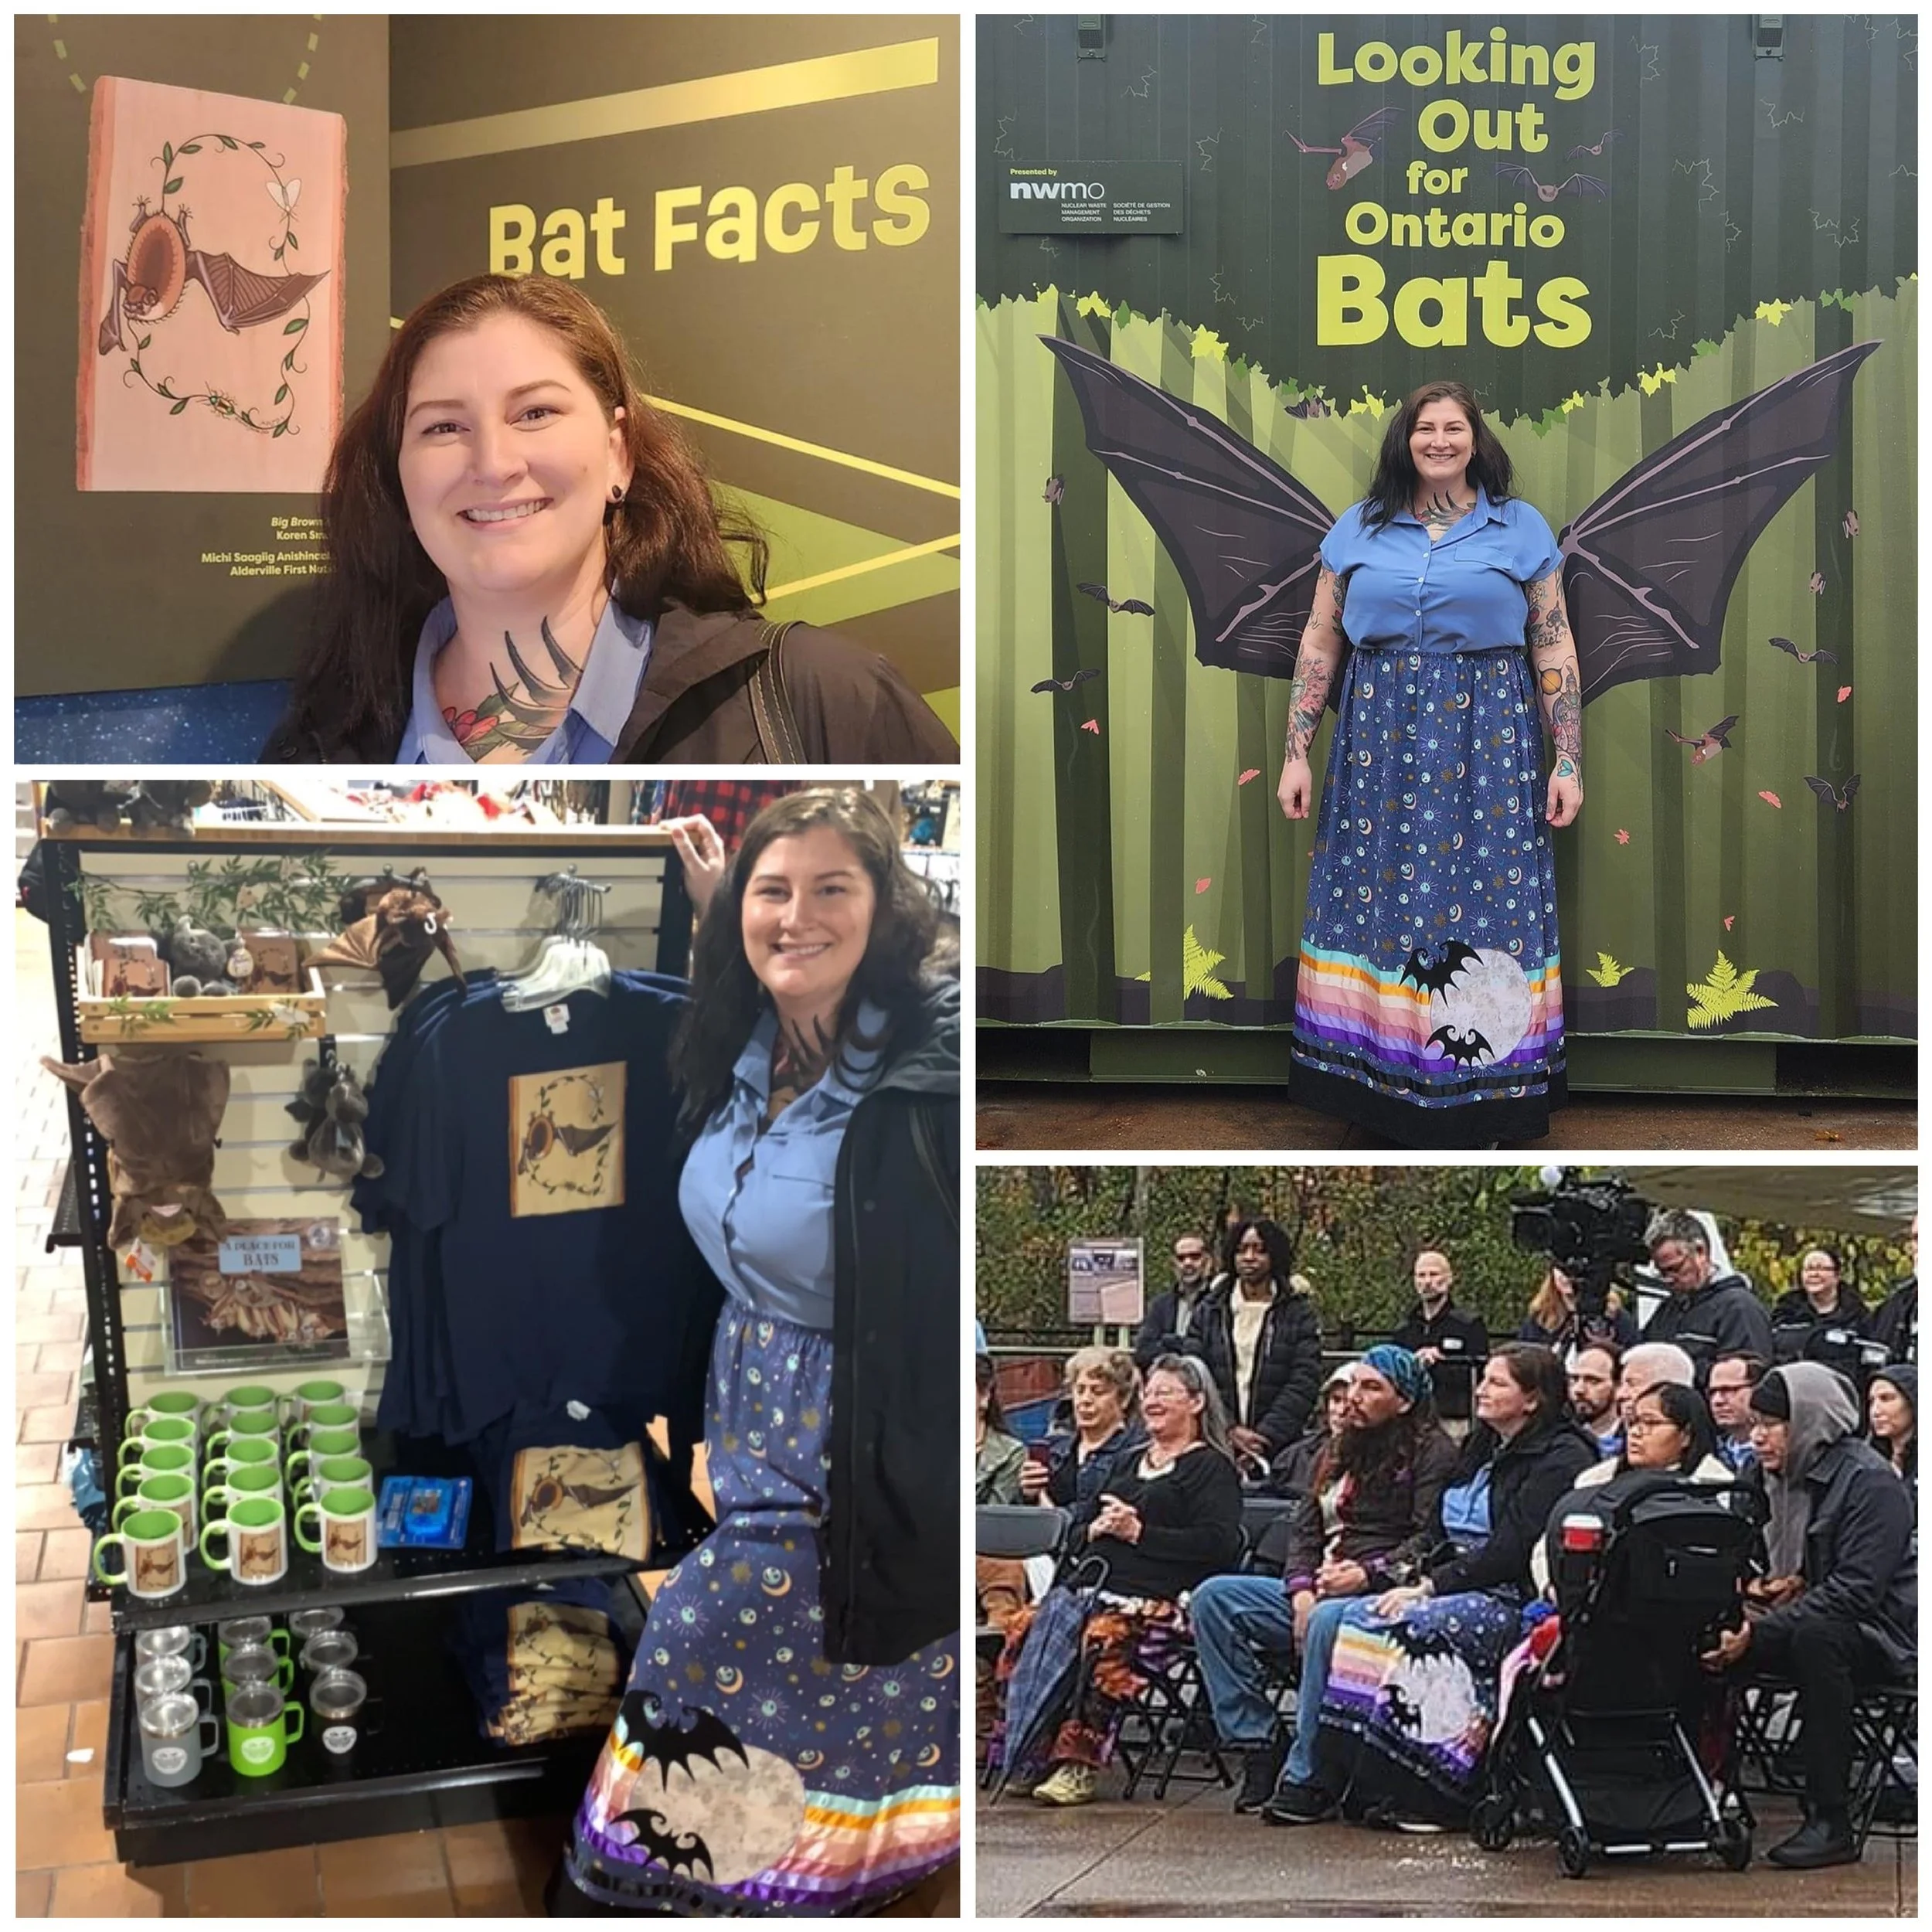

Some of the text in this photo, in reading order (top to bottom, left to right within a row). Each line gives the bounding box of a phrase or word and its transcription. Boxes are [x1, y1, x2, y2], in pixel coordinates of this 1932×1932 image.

[1318, 26, 1596, 100] Looking
[1417, 99, 1549, 153] Out
[1010, 182, 1105, 199] nwmo
[1406, 160, 1468, 195] for
[489, 163, 930, 280] Bat Facts
[1345, 202, 1566, 248] Ontario
[1317, 254, 1593, 349] Bats
[271, 517, 323, 529] Big Brown
[277, 530, 308, 540] Koren
[201, 553, 232, 563] Michi
[233, 552, 275, 564] Saagiig
[230, 565, 282, 576] Alderville
[284, 565, 308, 574] First
[243, 1253, 279, 1266] BATS
